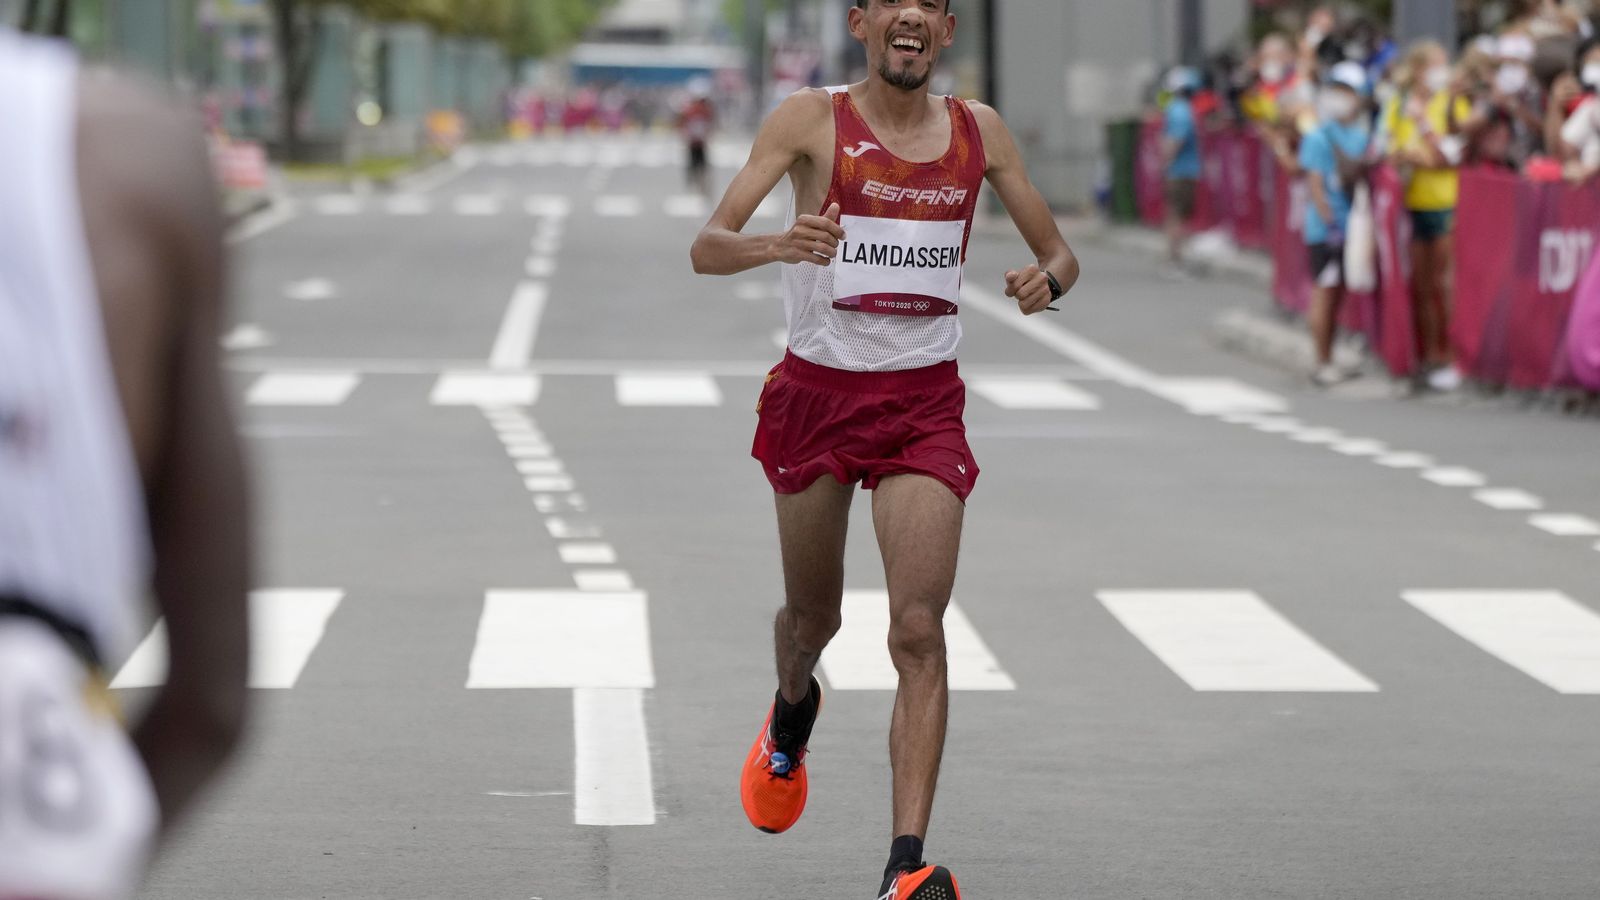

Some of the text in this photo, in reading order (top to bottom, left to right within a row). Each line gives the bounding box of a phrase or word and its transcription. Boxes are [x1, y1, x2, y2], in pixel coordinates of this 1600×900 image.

[861, 180, 968, 205] ESPAÑA
[842, 241, 960, 268] LAMDASSEM
[874, 300, 896, 308] TOKYO
